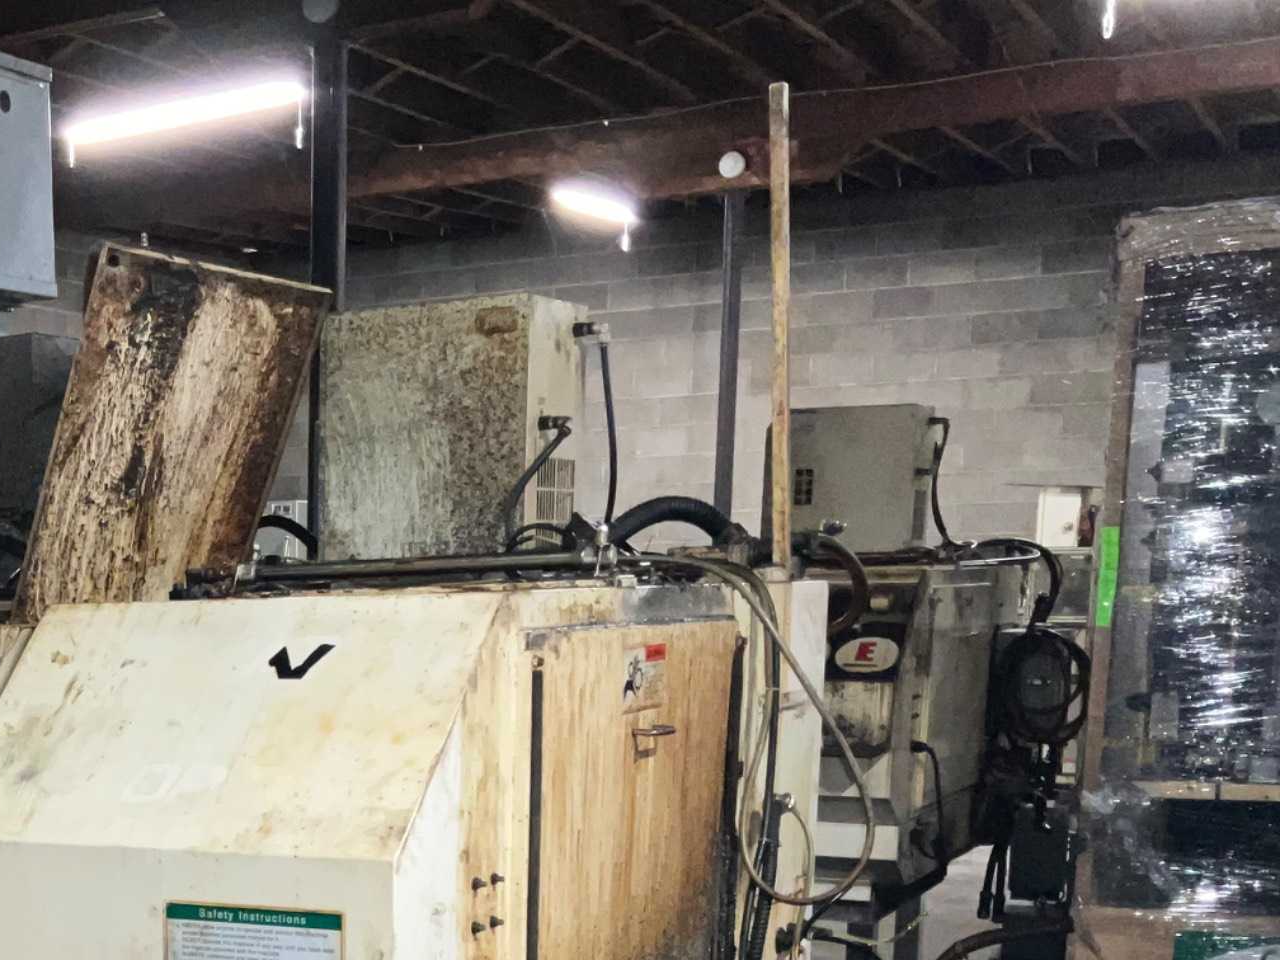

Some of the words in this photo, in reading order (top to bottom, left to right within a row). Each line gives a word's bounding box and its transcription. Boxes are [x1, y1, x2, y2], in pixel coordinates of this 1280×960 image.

[855, 641, 877, 661] E
[198, 908, 233, 921] Safety
[238, 910, 306, 924] Instructions
